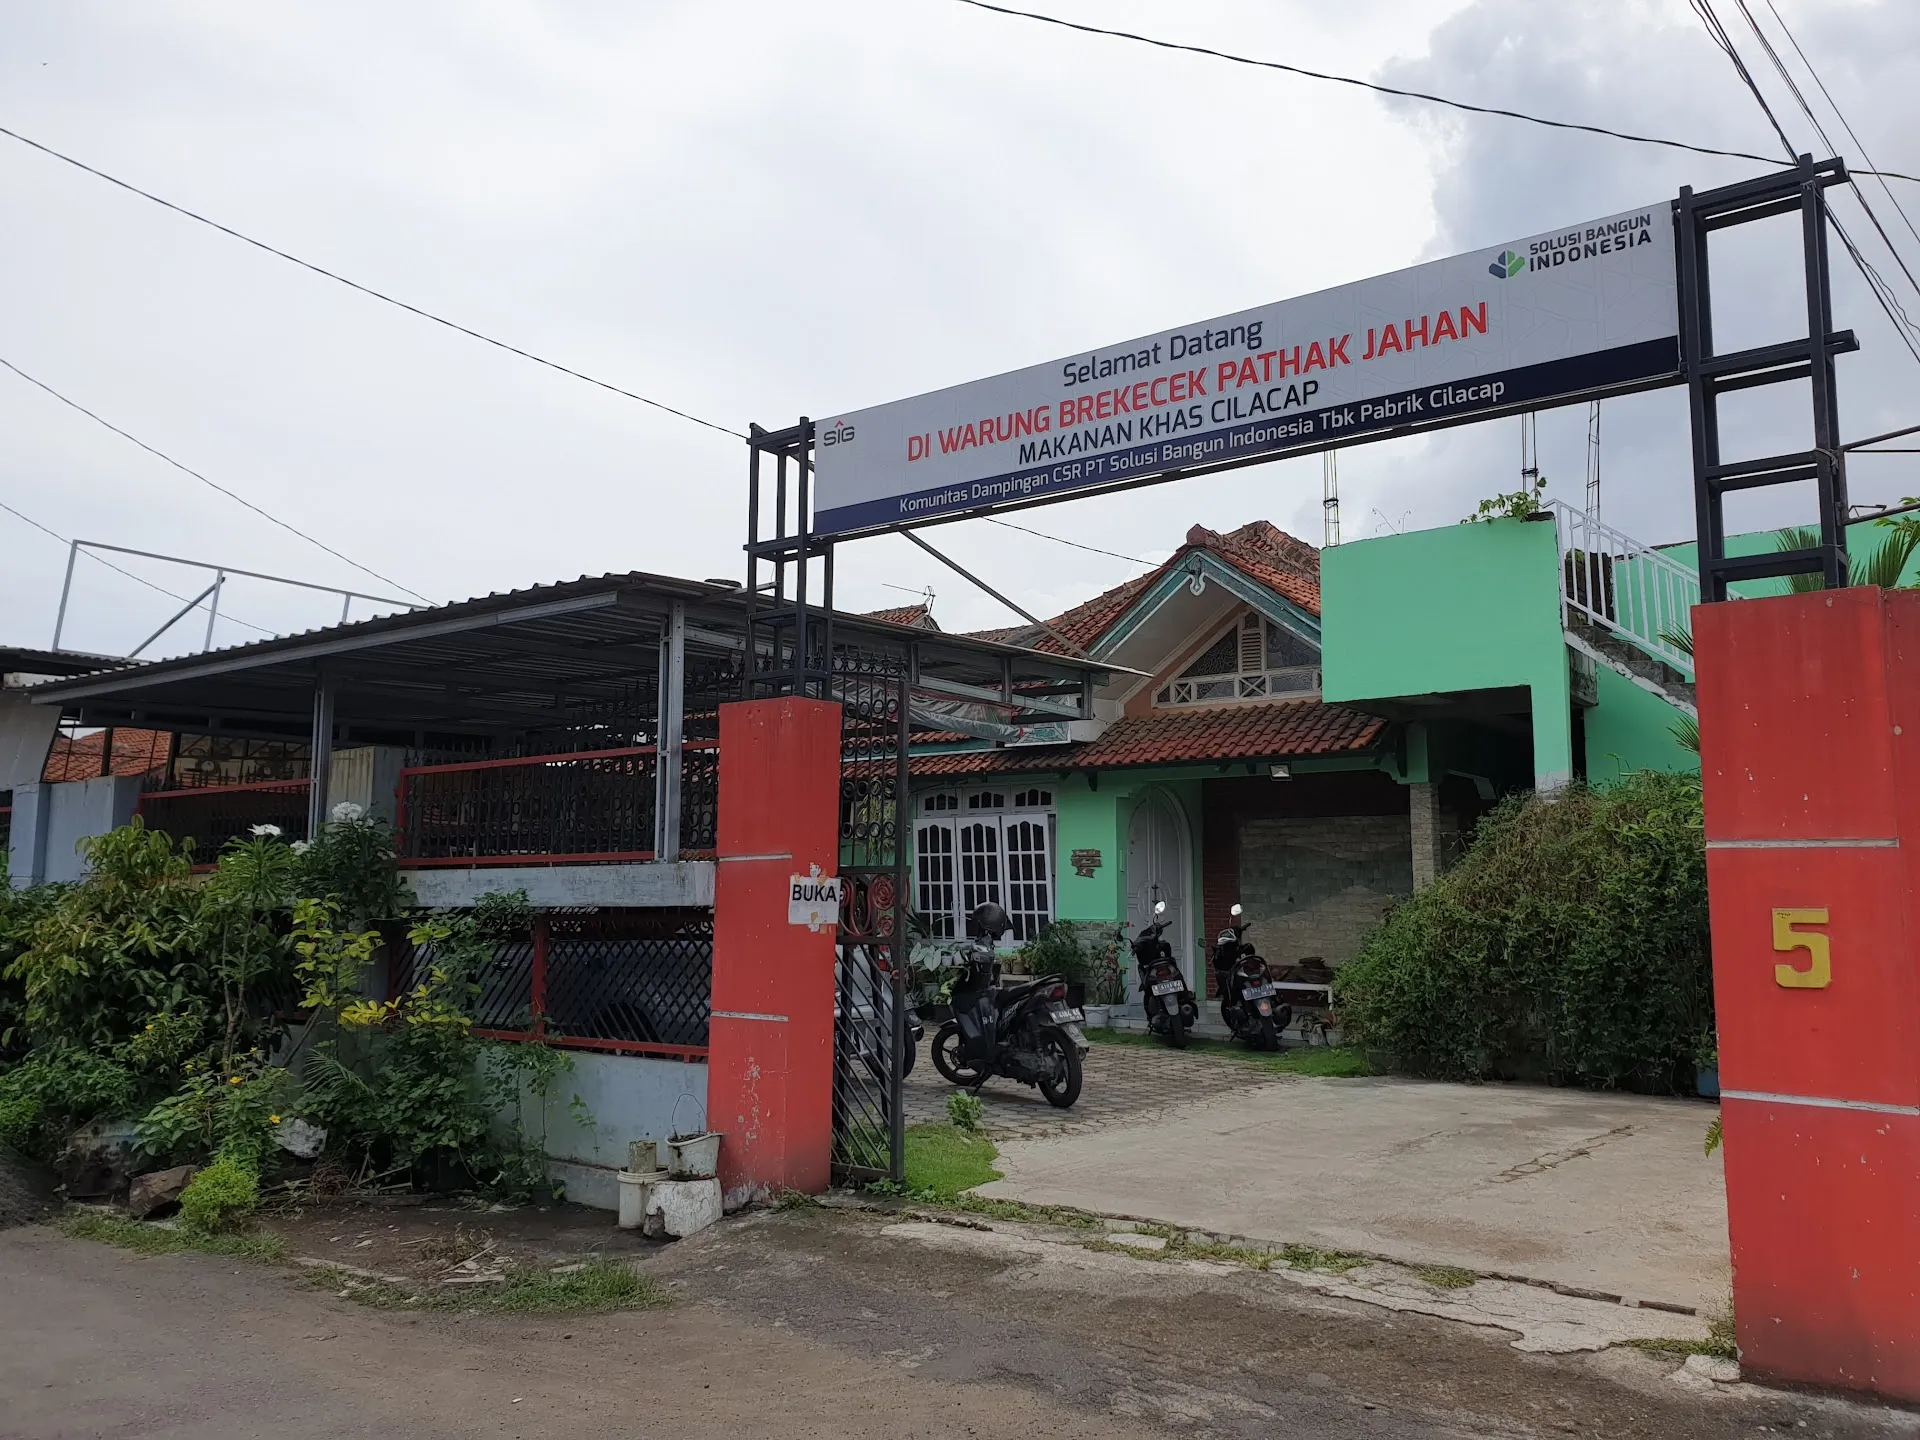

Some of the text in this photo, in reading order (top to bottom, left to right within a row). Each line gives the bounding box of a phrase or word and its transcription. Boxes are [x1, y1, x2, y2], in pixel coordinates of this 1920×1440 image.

[1529, 213, 1651, 256] SOLUSI BANGUN
[1529, 229, 1652, 272] INDONESIA
[908, 302, 1488, 462] DI WARUNG BREKECEK PATHAK JAHAN
[1063, 321, 1263, 387] Selamat Datang
[823, 421, 855, 447] SIG
[900, 380, 1505, 513] Komunitas Dampingan CSR PT Solusi Bangun Indonesia Tbk Pabrik Cilacap
[1018, 380, 1319, 465] MAKANAN KHAS CILACAP
[792, 884, 838, 902] BUKA
[1772, 907, 1832, 989] 5
